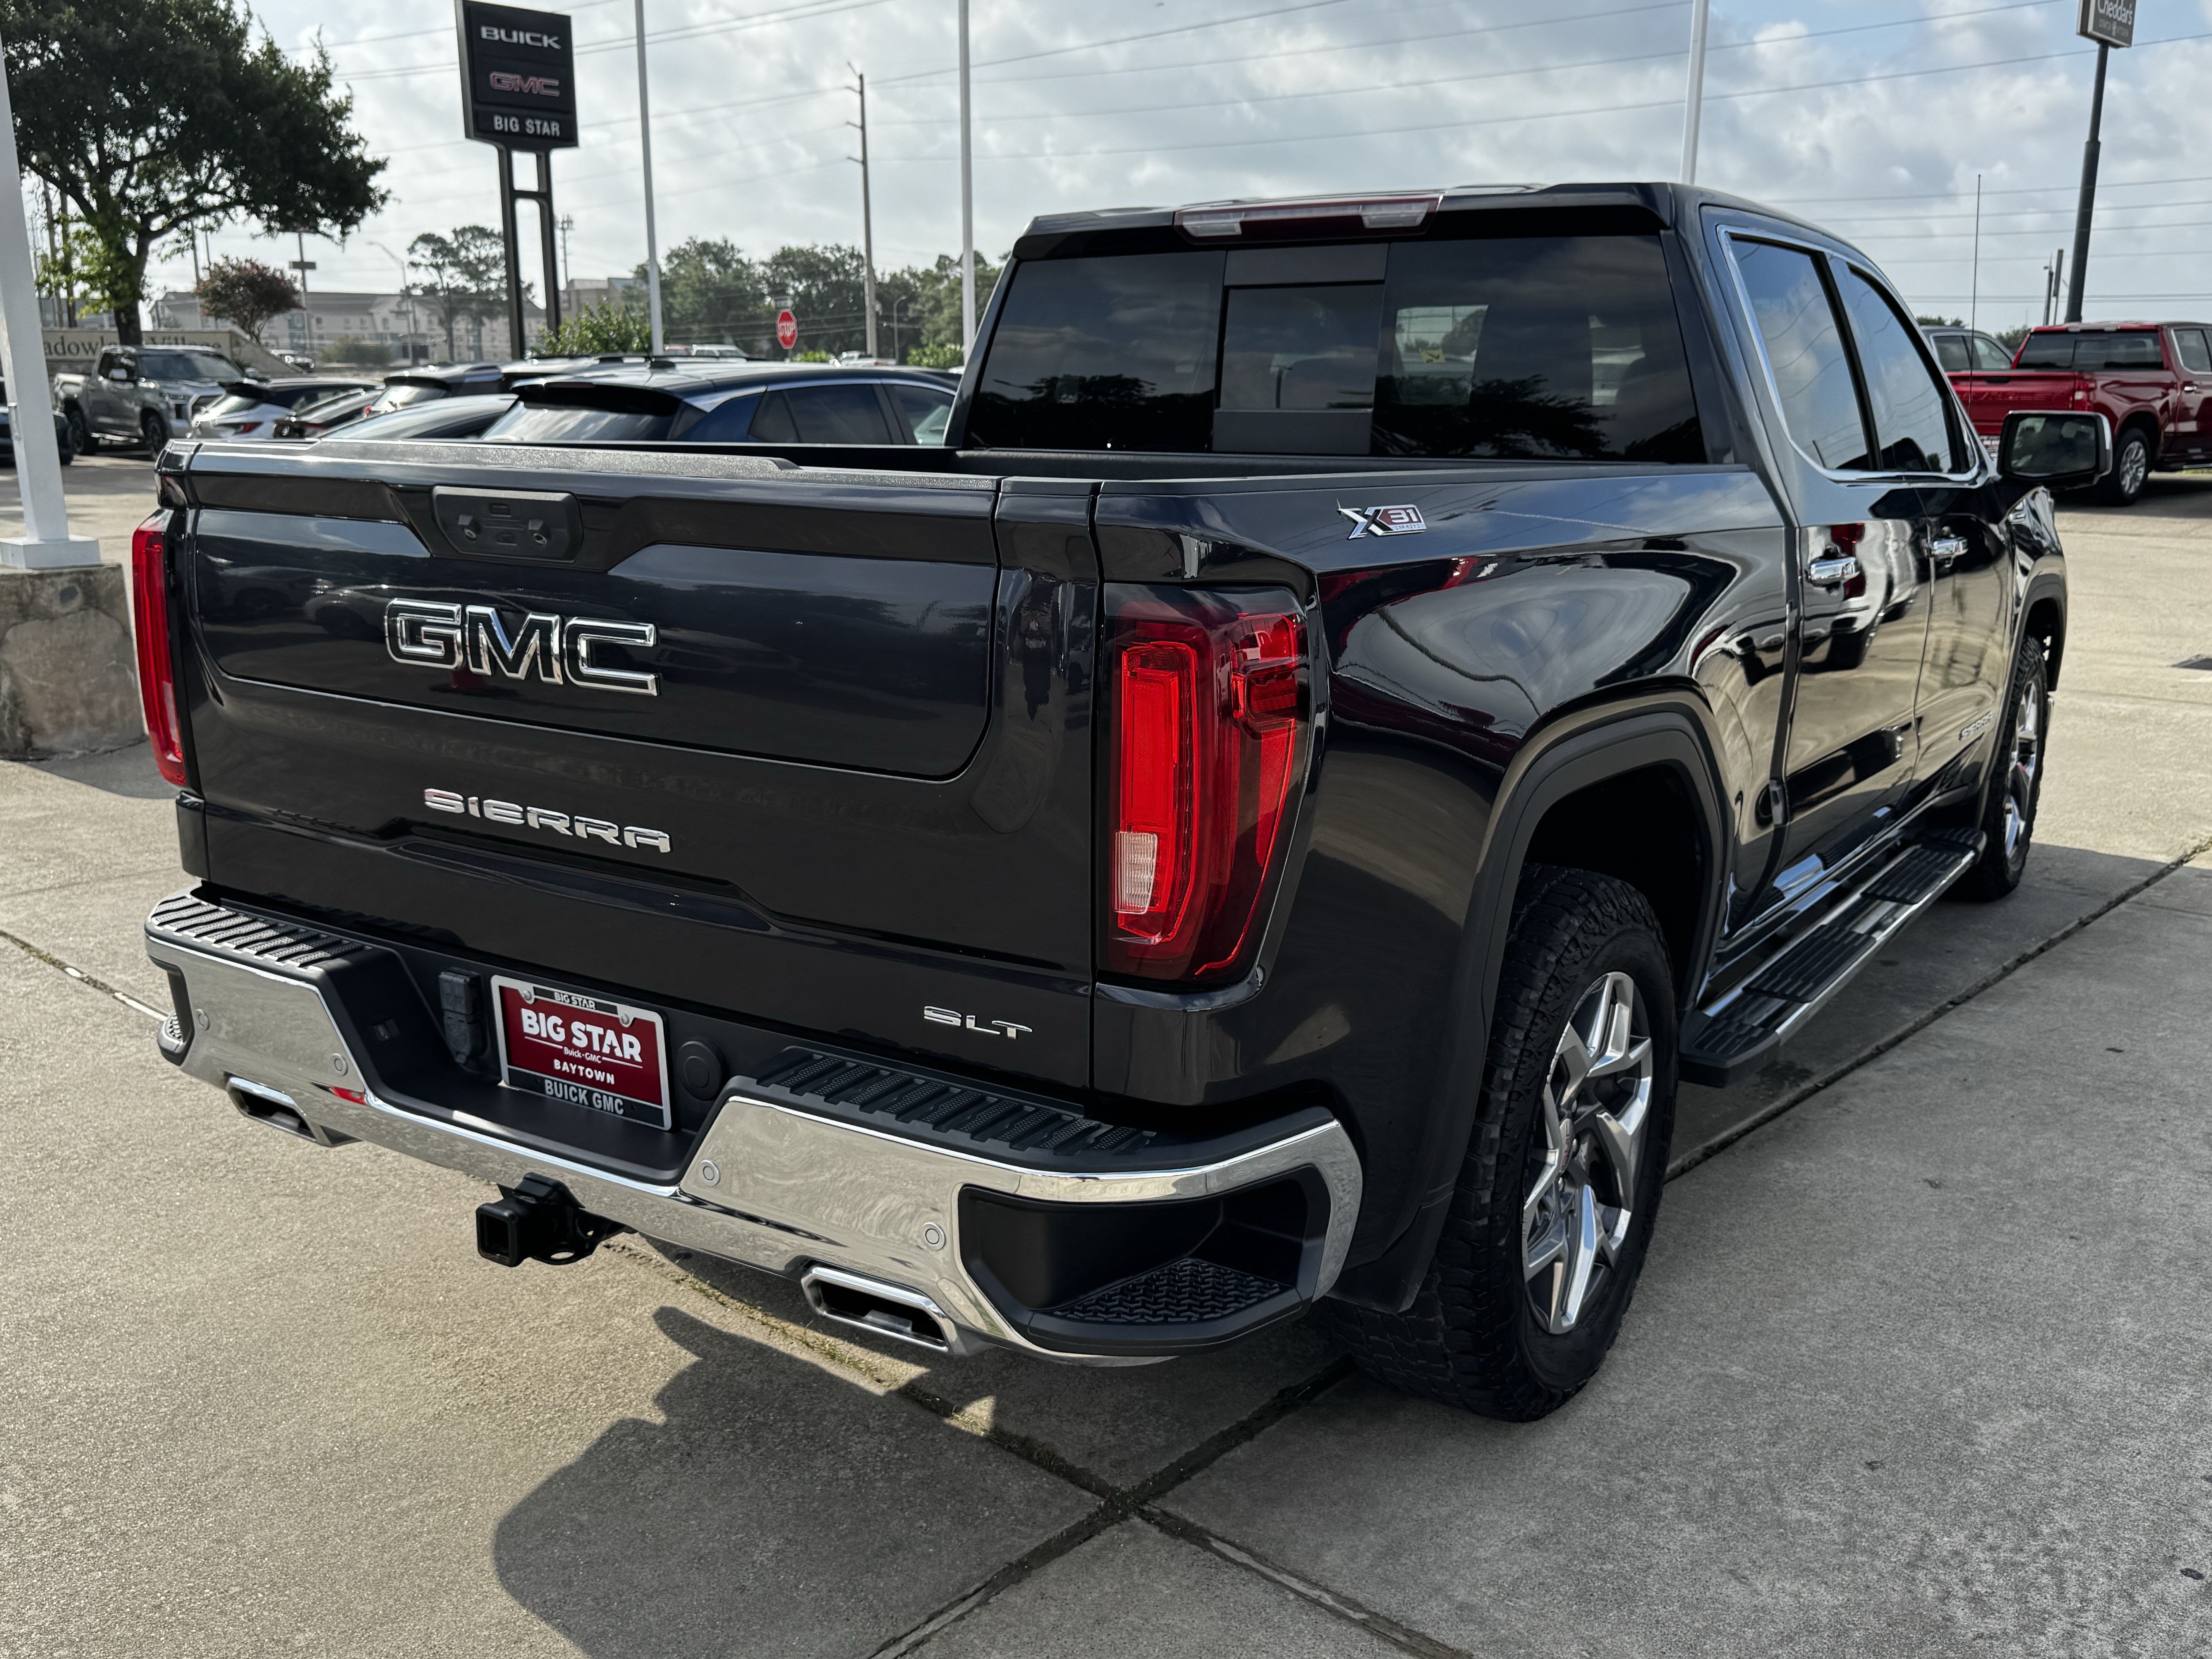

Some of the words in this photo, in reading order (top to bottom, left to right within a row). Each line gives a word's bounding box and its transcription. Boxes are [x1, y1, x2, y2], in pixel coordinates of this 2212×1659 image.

[2097, 0, 2132, 25] Cheddar's
[480, 26, 562, 50] BUICK
[489, 71, 560, 97] GMC
[493, 115, 519, 132] BIG
[526, 118, 560, 137] STAR
[778, 322, 796, 337] STOP
[385, 598, 660, 696] GMC
[424, 788, 672, 853] SIERRA
[554, 992, 570, 1003] BIG
[571, 996, 596, 1010] STAR
[521, 1008, 565, 1042] BIG
[571, 1022, 642, 1062] STAR
[924, 1006, 1032, 1039] SLT
[553, 1059, 615, 1084] BAYTOWN
[544, 1079, 589, 1105] BUICK
[592, 1092, 624, 1115] GMC
